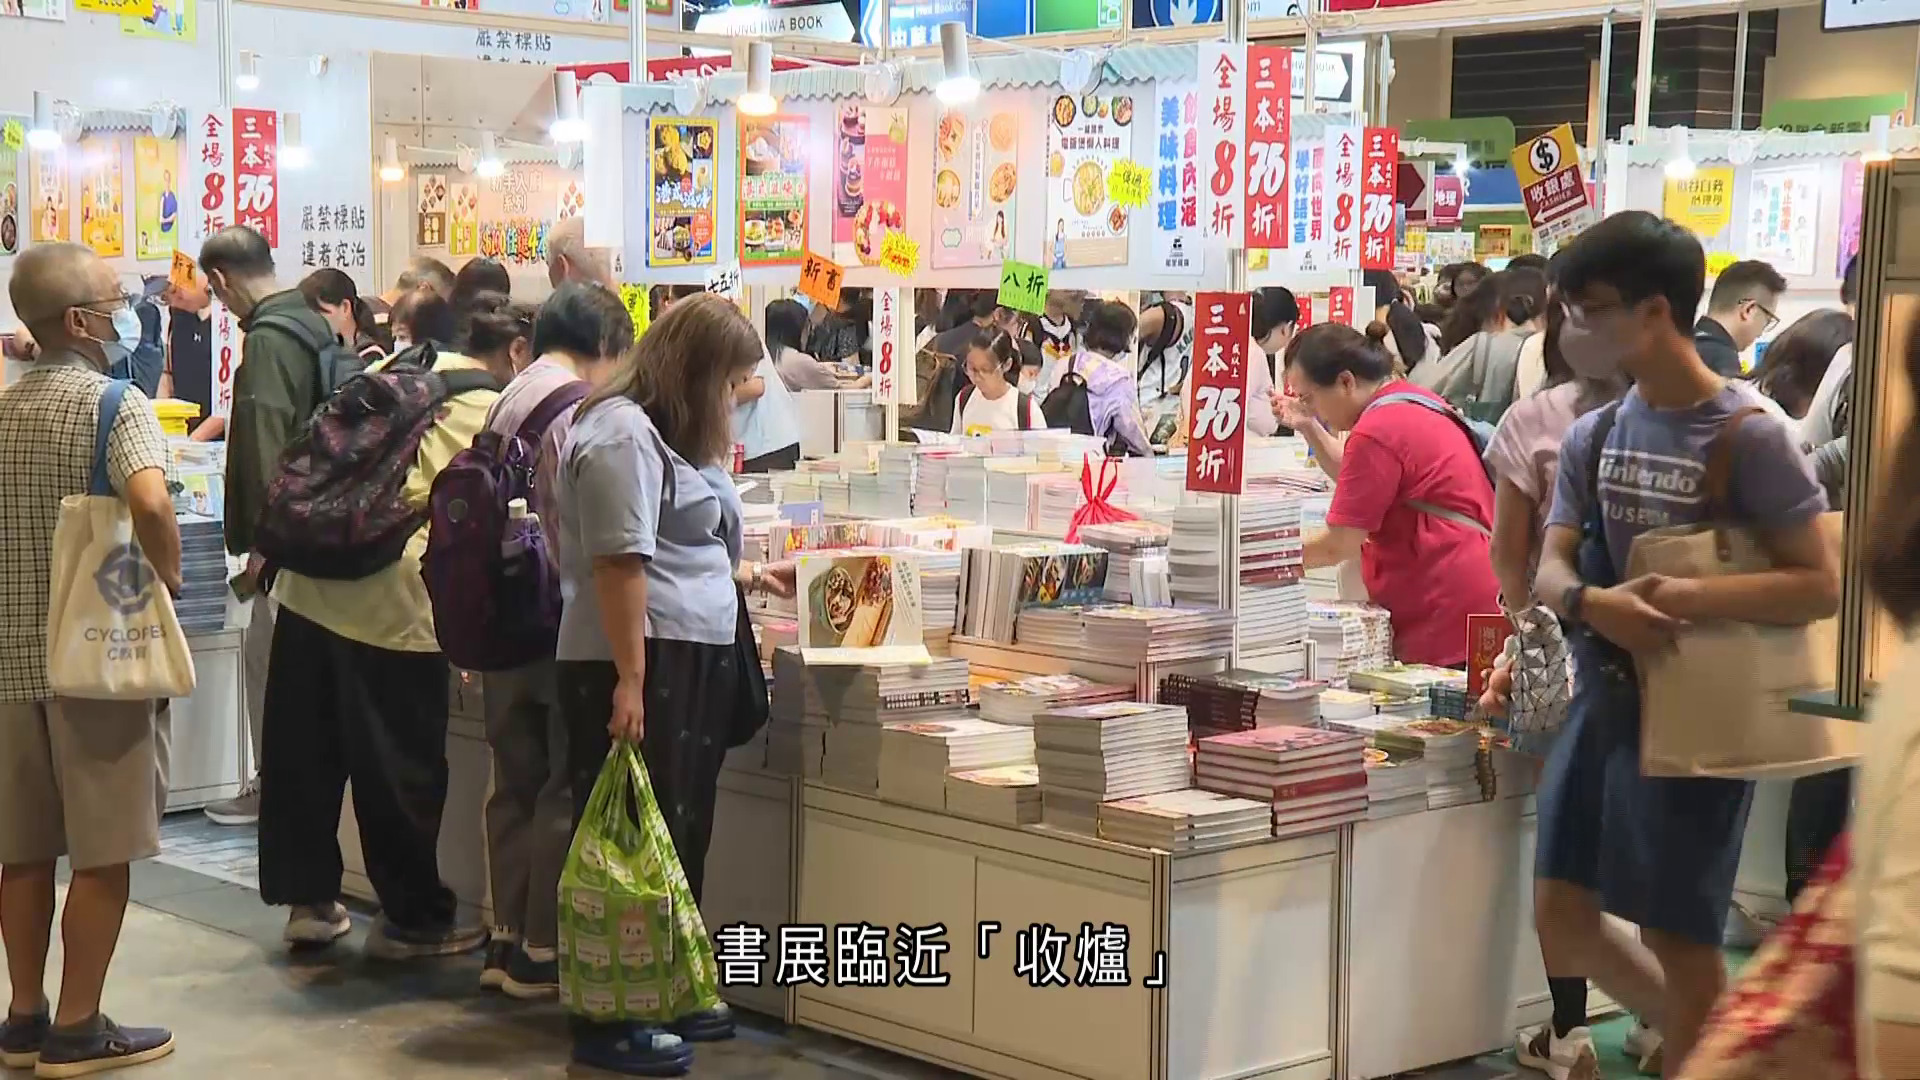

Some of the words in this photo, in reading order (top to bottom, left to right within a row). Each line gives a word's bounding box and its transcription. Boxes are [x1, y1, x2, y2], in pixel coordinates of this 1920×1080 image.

[790, 15, 823, 31] BOOK
[475, 28, 551, 51] 嚴禁標貼
[1211, 53, 1237, 239] 全場8折
[1248, 57, 1286, 240] 三本75折
[1158, 95, 1180, 231] 美味料理
[503, 192, 528, 212] 系列
[1334, 132, 1355, 261] 全場8折
[1362, 134, 1393, 263] 三本75折
[1435, 190, 1457, 206] 地理
[1530, 170, 1575, 203] 收銀處
[301, 205, 366, 231] 嚴禁標貼
[301, 242, 366, 268] 違者究治
[708, 270, 740, 293] 七五折
[1003, 266, 1044, 297] 八折
[880, 291, 894, 400] 全場8折
[1192, 304, 1241, 484] 三本75折
